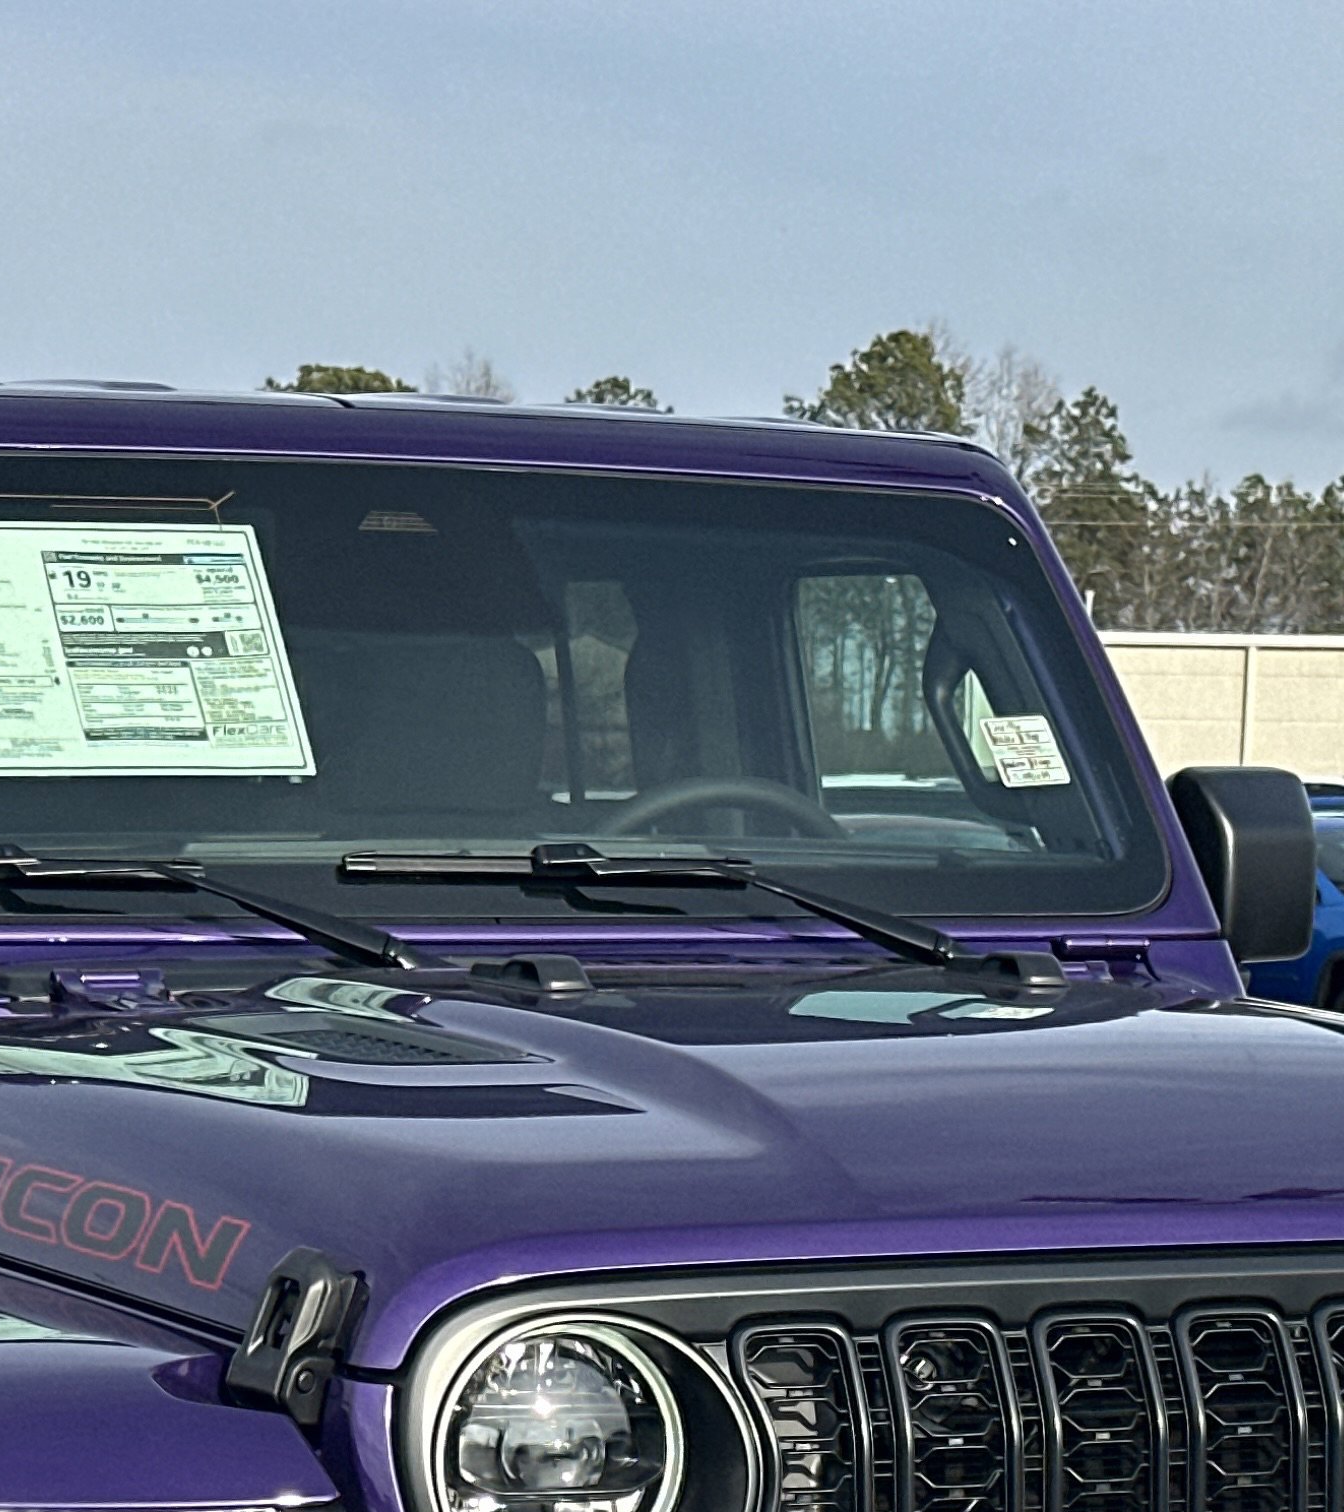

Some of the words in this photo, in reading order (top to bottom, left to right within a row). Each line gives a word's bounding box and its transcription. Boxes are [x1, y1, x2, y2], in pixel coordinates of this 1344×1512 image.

[62, 570, 92, 588] 19
[60, 615, 104, 626] $2,600
[213, 724, 286, 736] FlexCare
